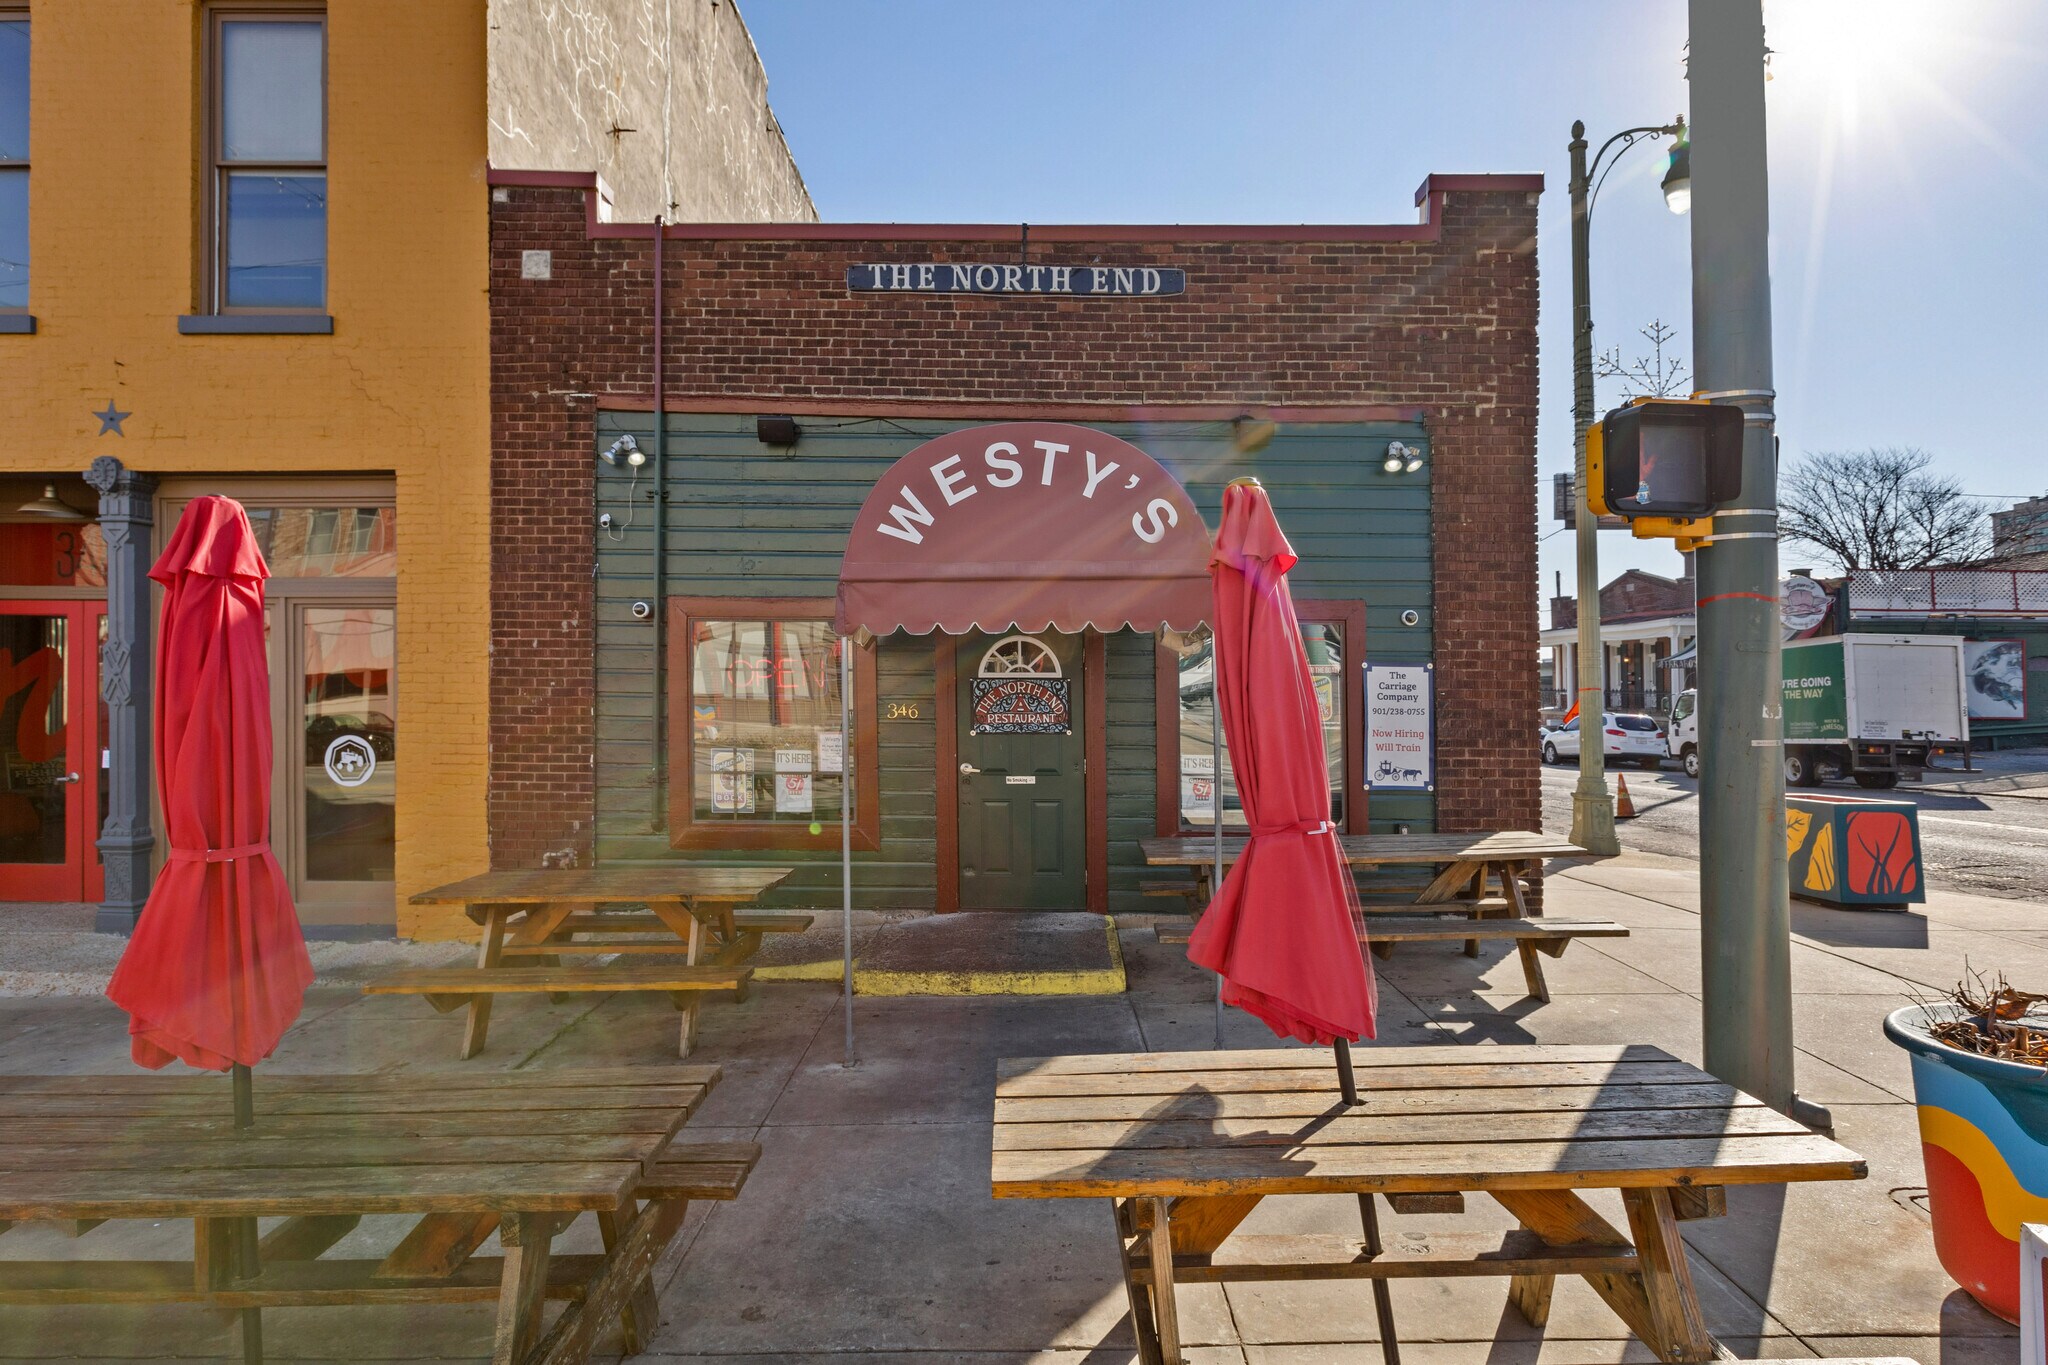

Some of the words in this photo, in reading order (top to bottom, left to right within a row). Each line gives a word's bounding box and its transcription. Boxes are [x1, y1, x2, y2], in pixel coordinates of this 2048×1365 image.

[868, 263, 936, 290] THE
[950, 264, 1073, 292] NORTH
[1091, 267, 1161, 294] END
[876, 440, 1179, 545] WESTY'S
[727, 658, 825, 688] OPEN
[1389, 671, 1407, 680] The
[1378, 682, 1417, 692] Carriage
[1800, 676, 1831, 688] GOING
[976, 690, 999, 714] THE
[998, 681, 1043, 699] NORTH
[1042, 692, 1065, 714] END
[1377, 692, 1419, 702] Company
[1784, 690, 1802, 699] THE
[1803, 689, 1824, 699] WAY
[887, 703, 919, 719] 346
[1372, 707, 1425, 716] 901/238-0755
[987, 713, 1057, 724] RESTAURANT
[1372, 729, 1393, 738] Now
[1394, 729, 1425, 740] Hiring
[1375, 743, 1394, 752] Will
[1395, 743, 1421, 752] Train
[776, 753, 791, 764] IT'S
[791, 753, 811, 764] HERE
[1199, 757, 1214, 768] HER
